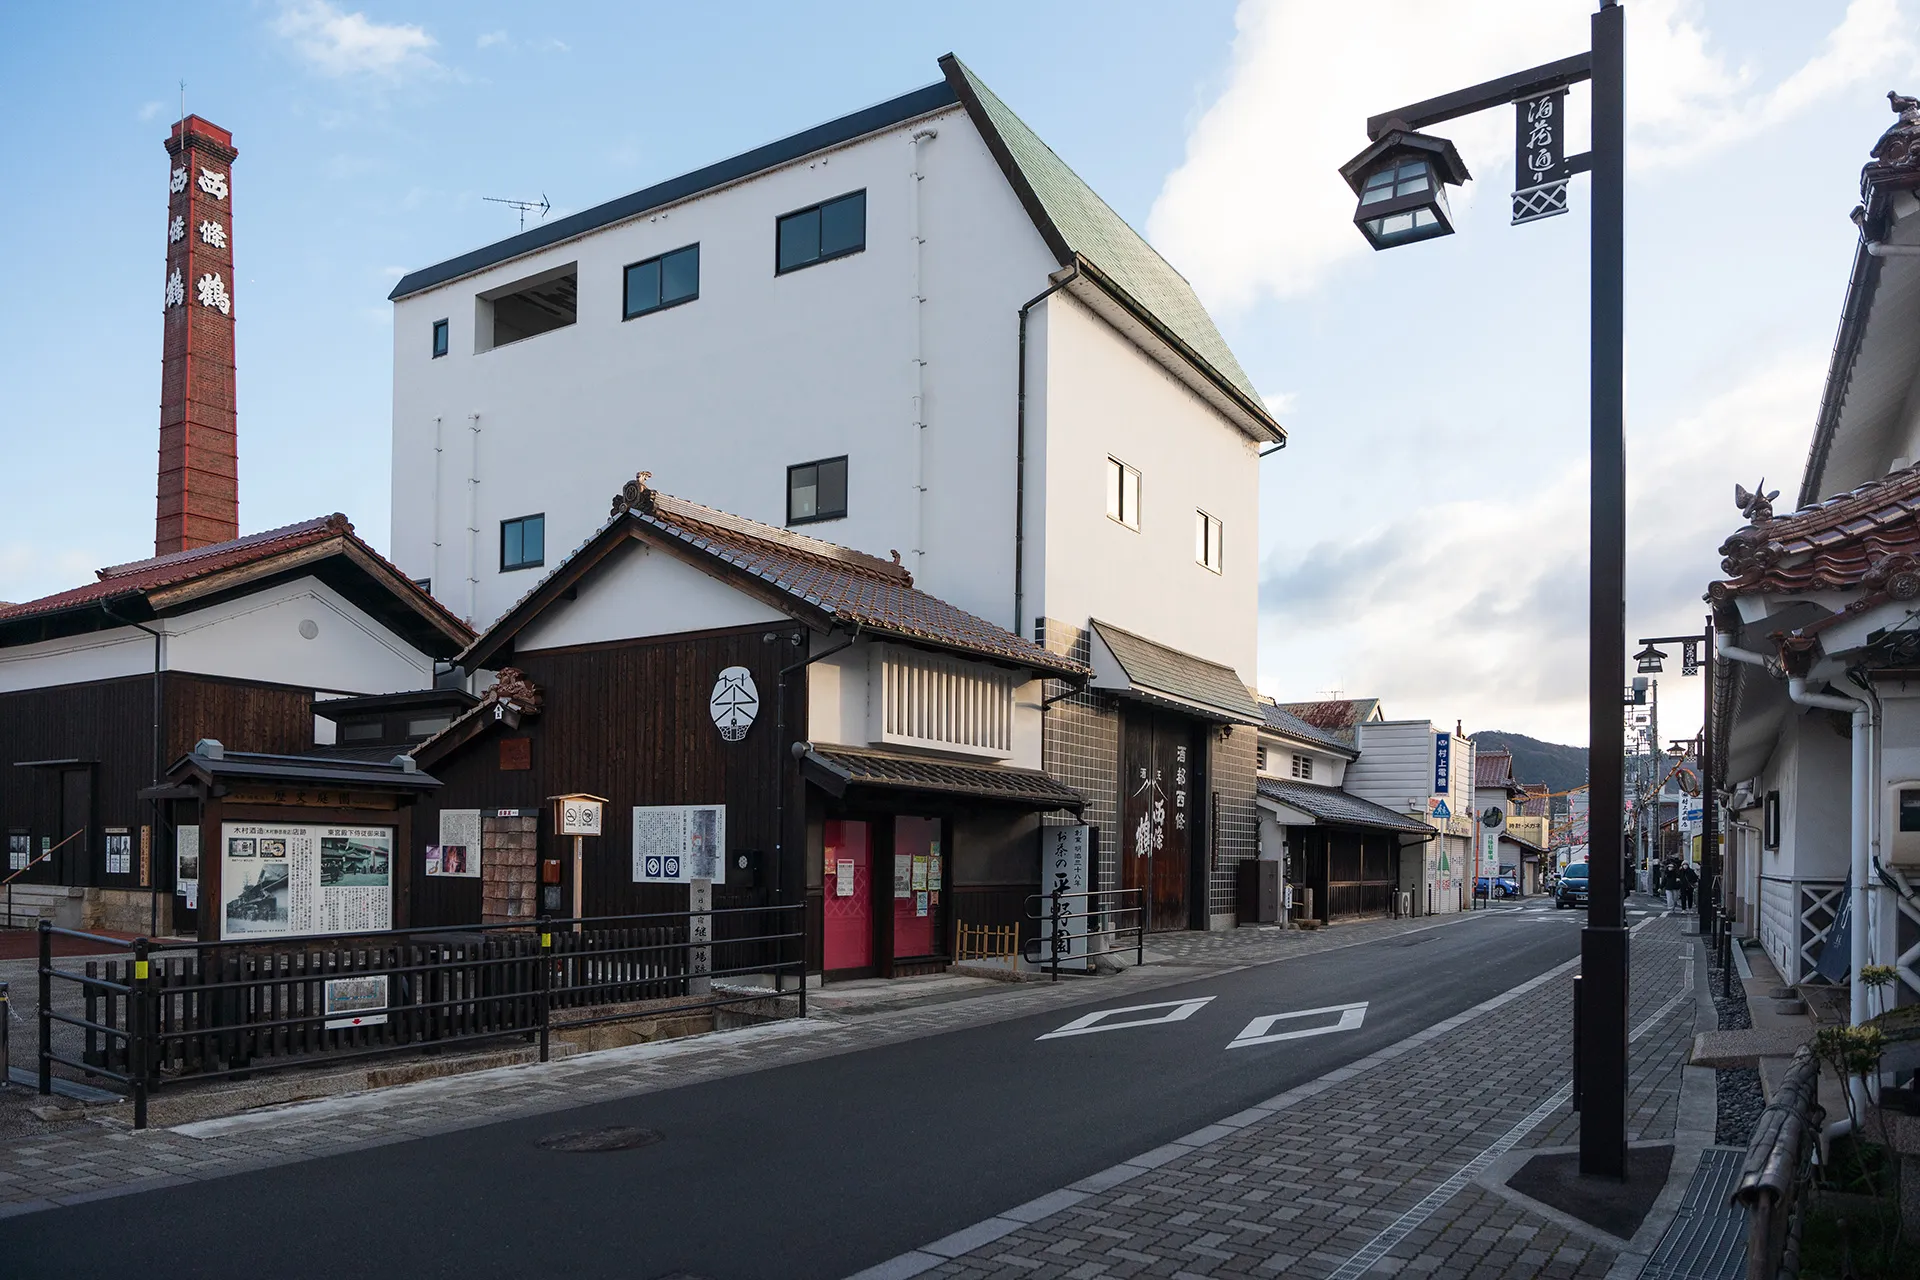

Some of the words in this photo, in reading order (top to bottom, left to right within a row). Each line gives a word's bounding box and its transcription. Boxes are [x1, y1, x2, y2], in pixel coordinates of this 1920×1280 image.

[1526, 96, 1555, 183] 酒蔵通り
[198, 168, 230, 315] 西條鶴
[1437, 749, 1447, 787] 村上電機
